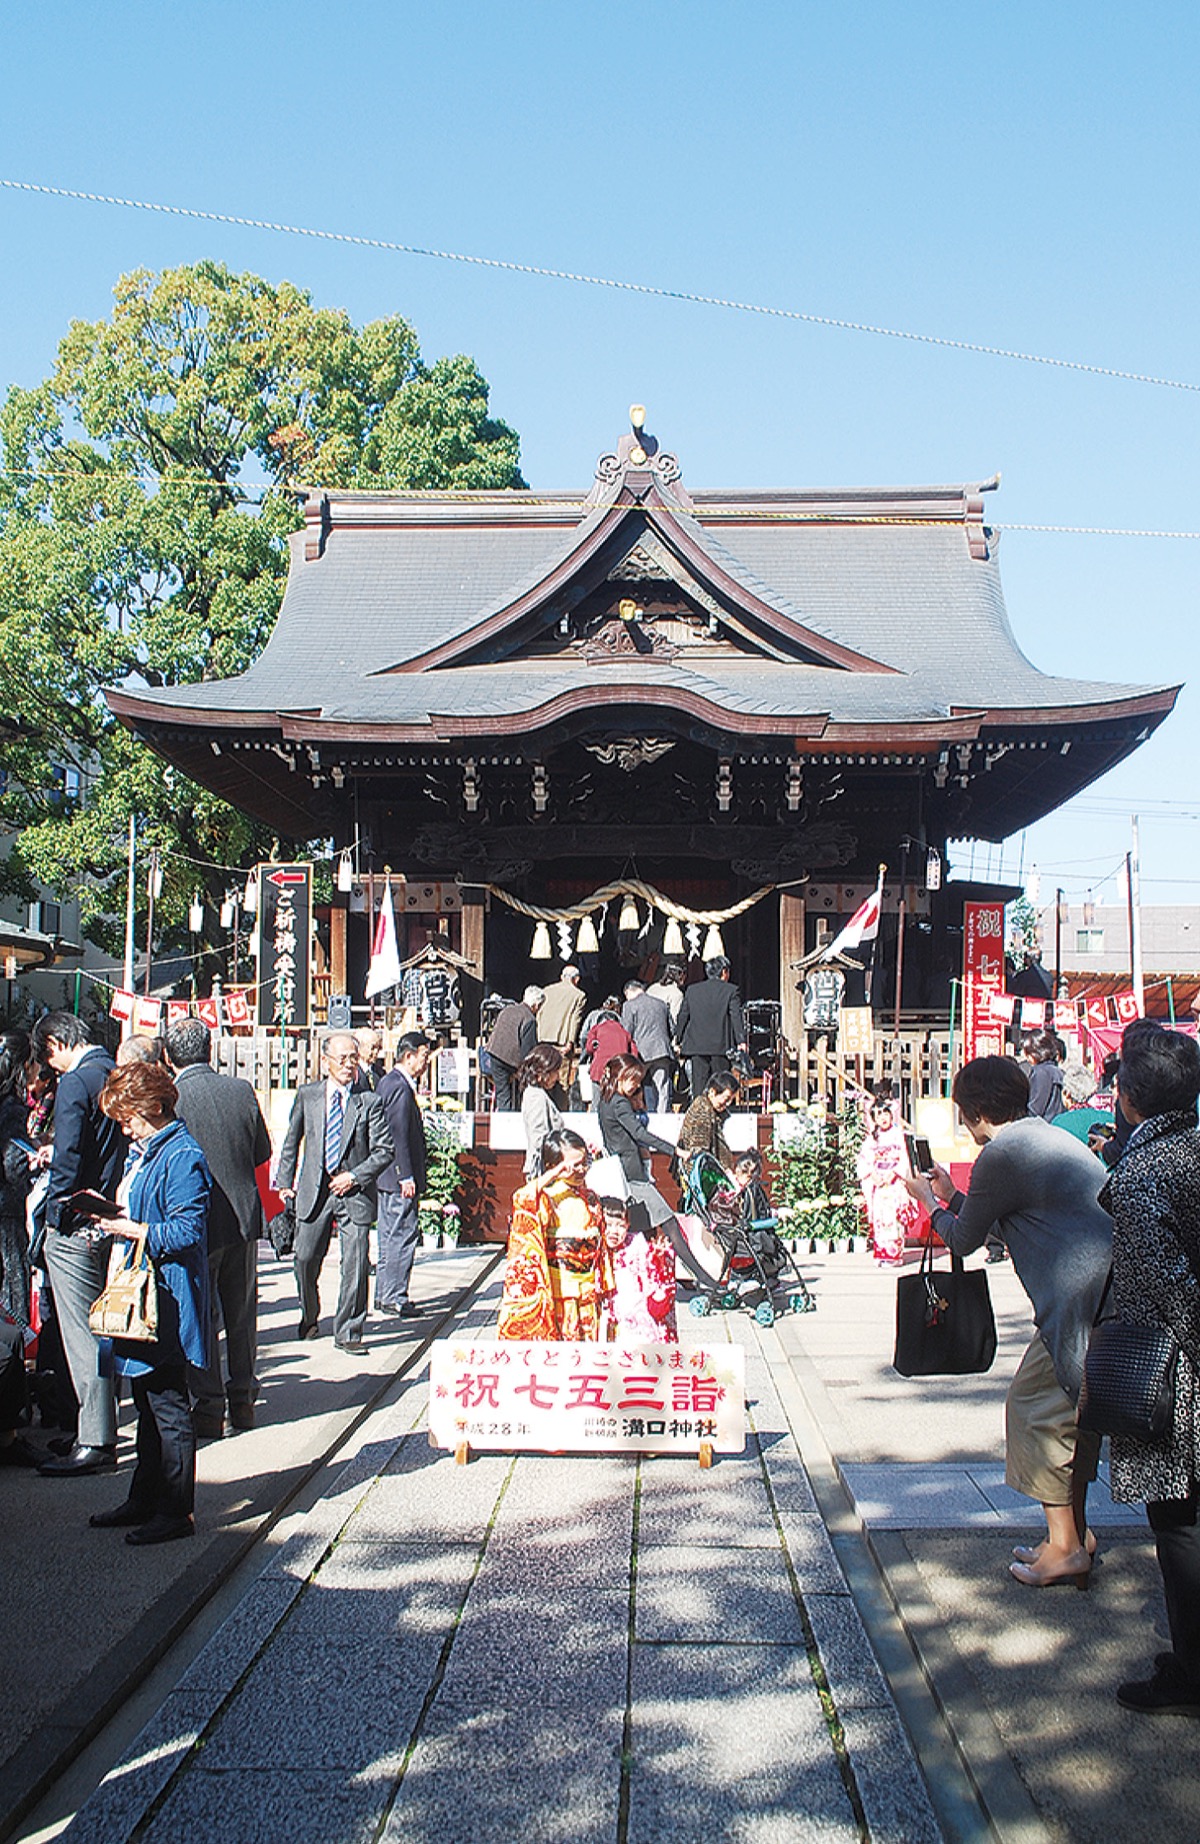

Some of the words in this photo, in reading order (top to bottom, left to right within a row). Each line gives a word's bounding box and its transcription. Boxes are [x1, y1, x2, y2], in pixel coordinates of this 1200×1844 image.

[454, 1372, 717, 1412] 祝七五三詣
[622, 1417, 718, 1438] 溝口神社
